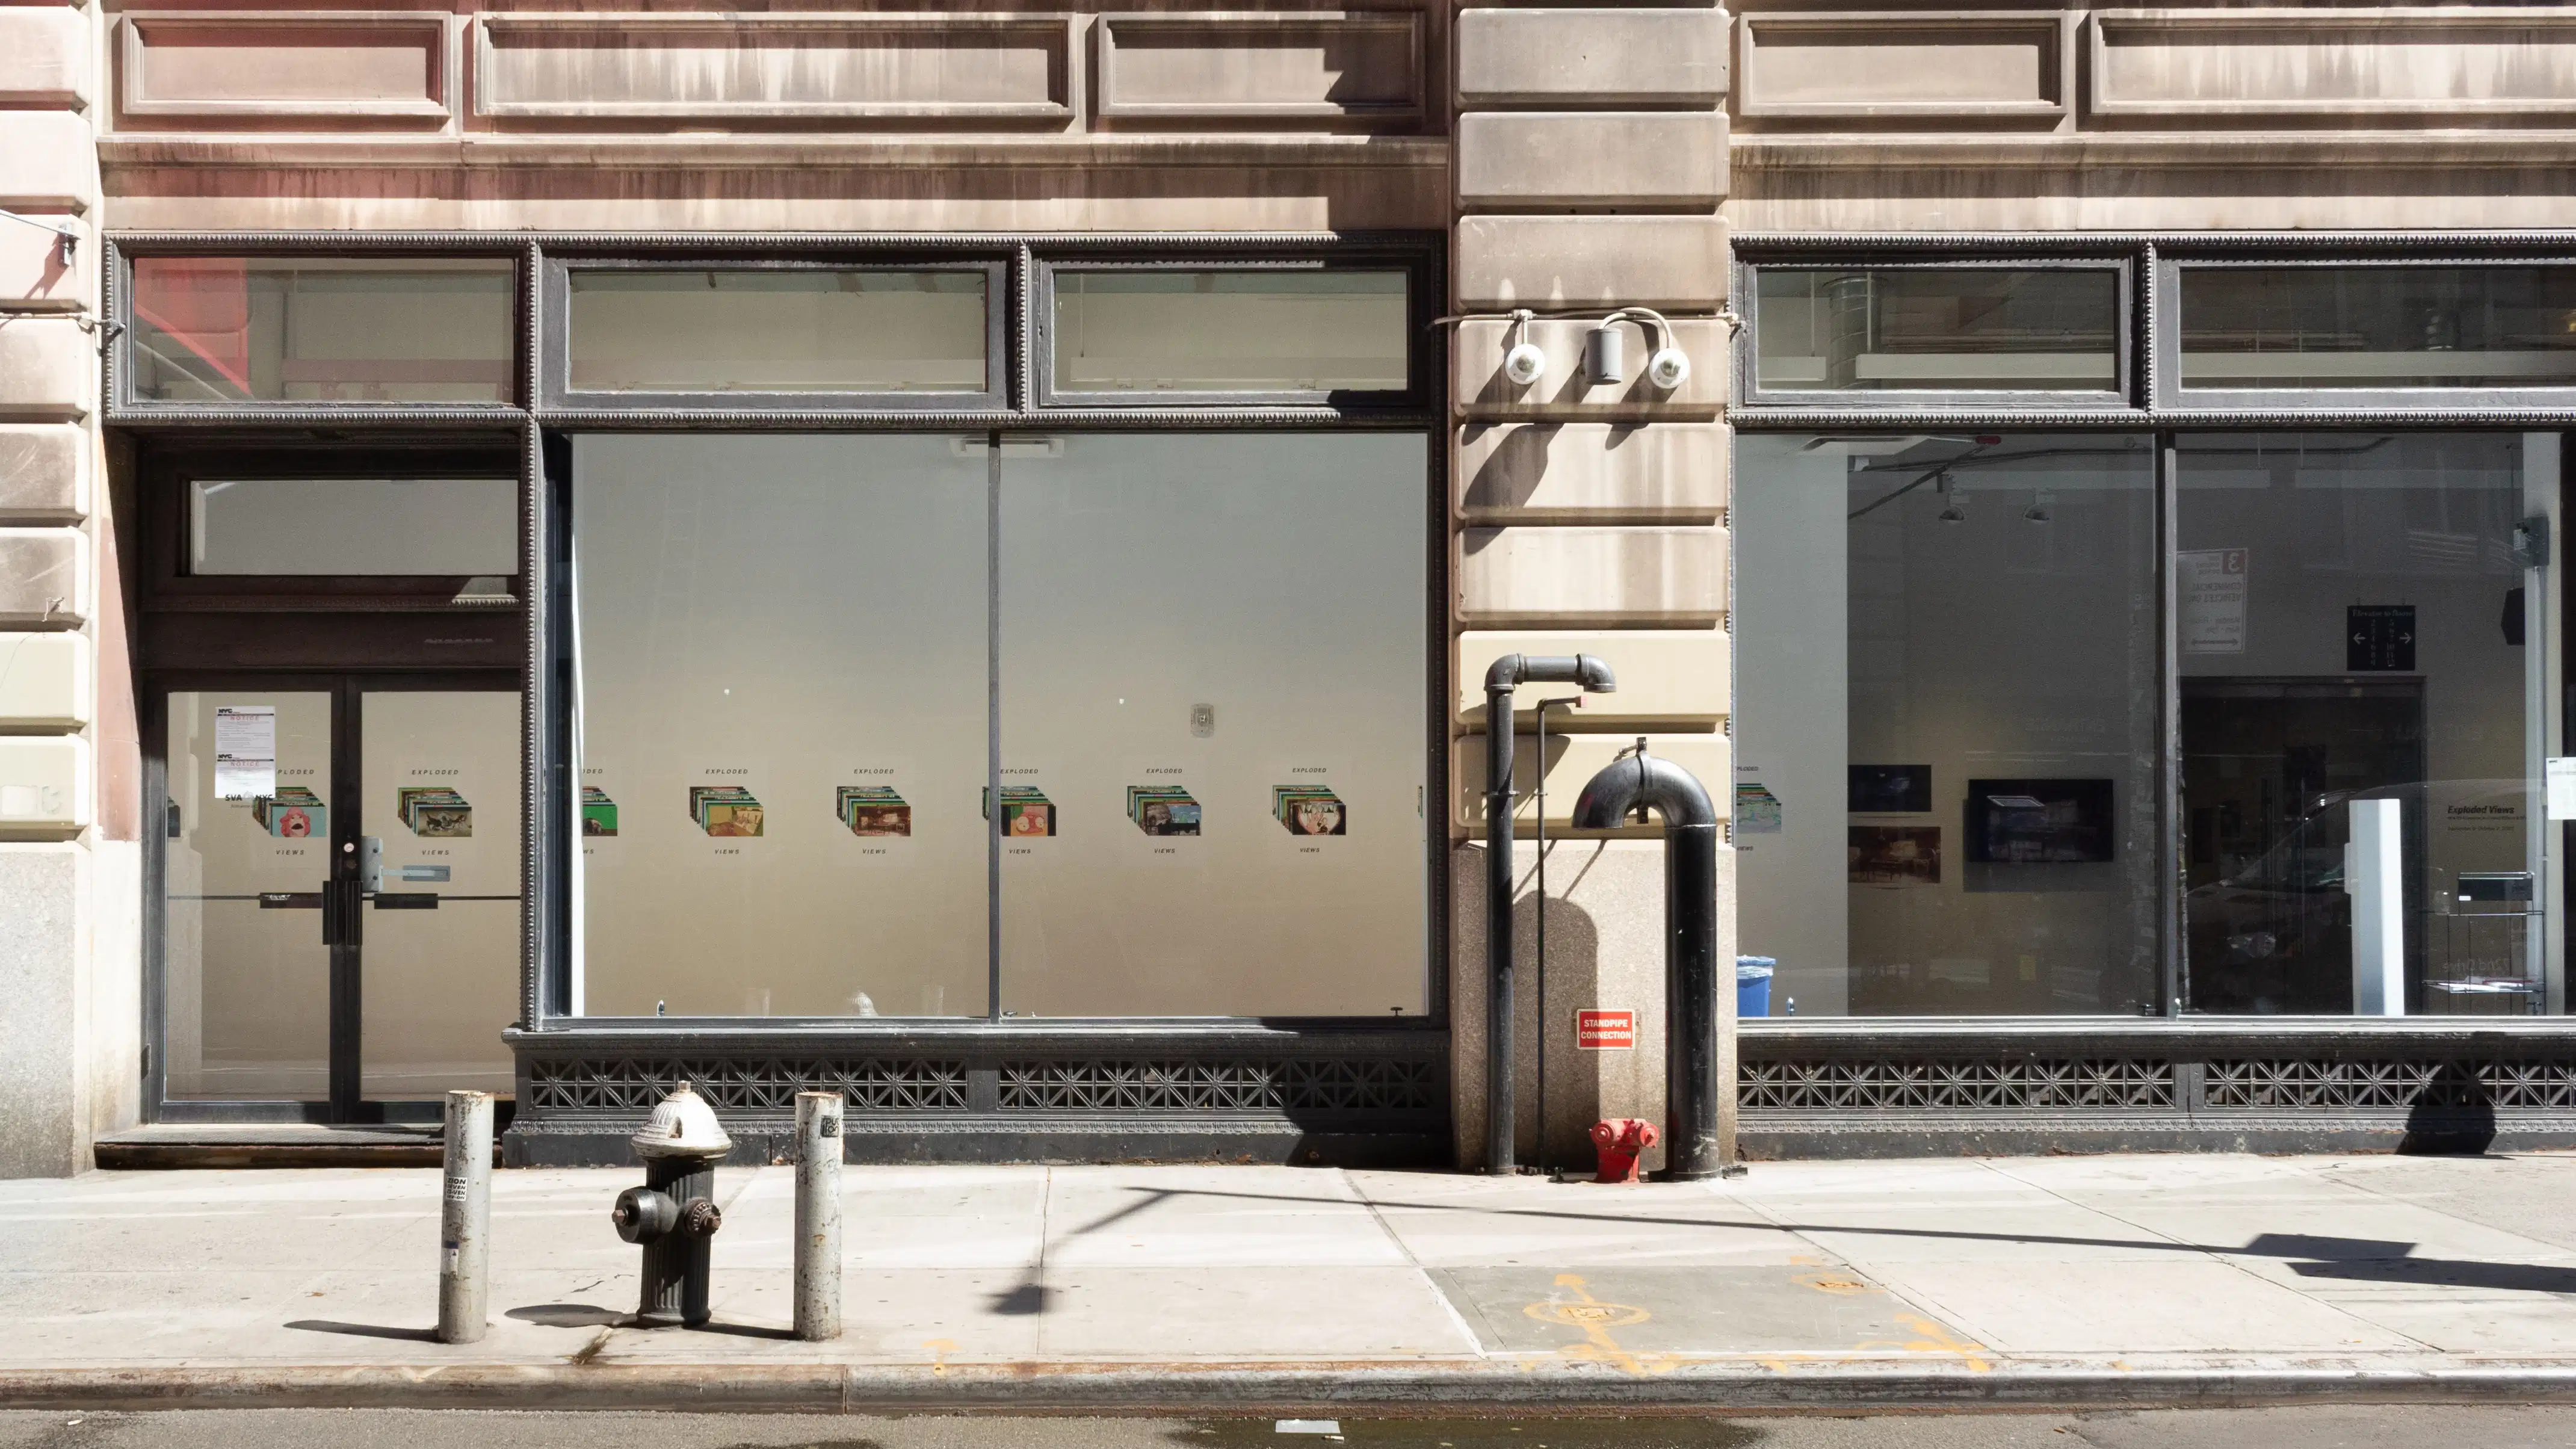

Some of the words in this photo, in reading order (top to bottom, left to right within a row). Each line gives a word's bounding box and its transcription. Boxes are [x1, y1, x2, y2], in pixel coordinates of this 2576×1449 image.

[2447, 805, 2487, 815] Exploded
[2489, 805, 2515, 814] Views
[1584, 1019, 1629, 1028] STANDPIPE
[1581, 1031, 1632, 1040] CONNECTION
